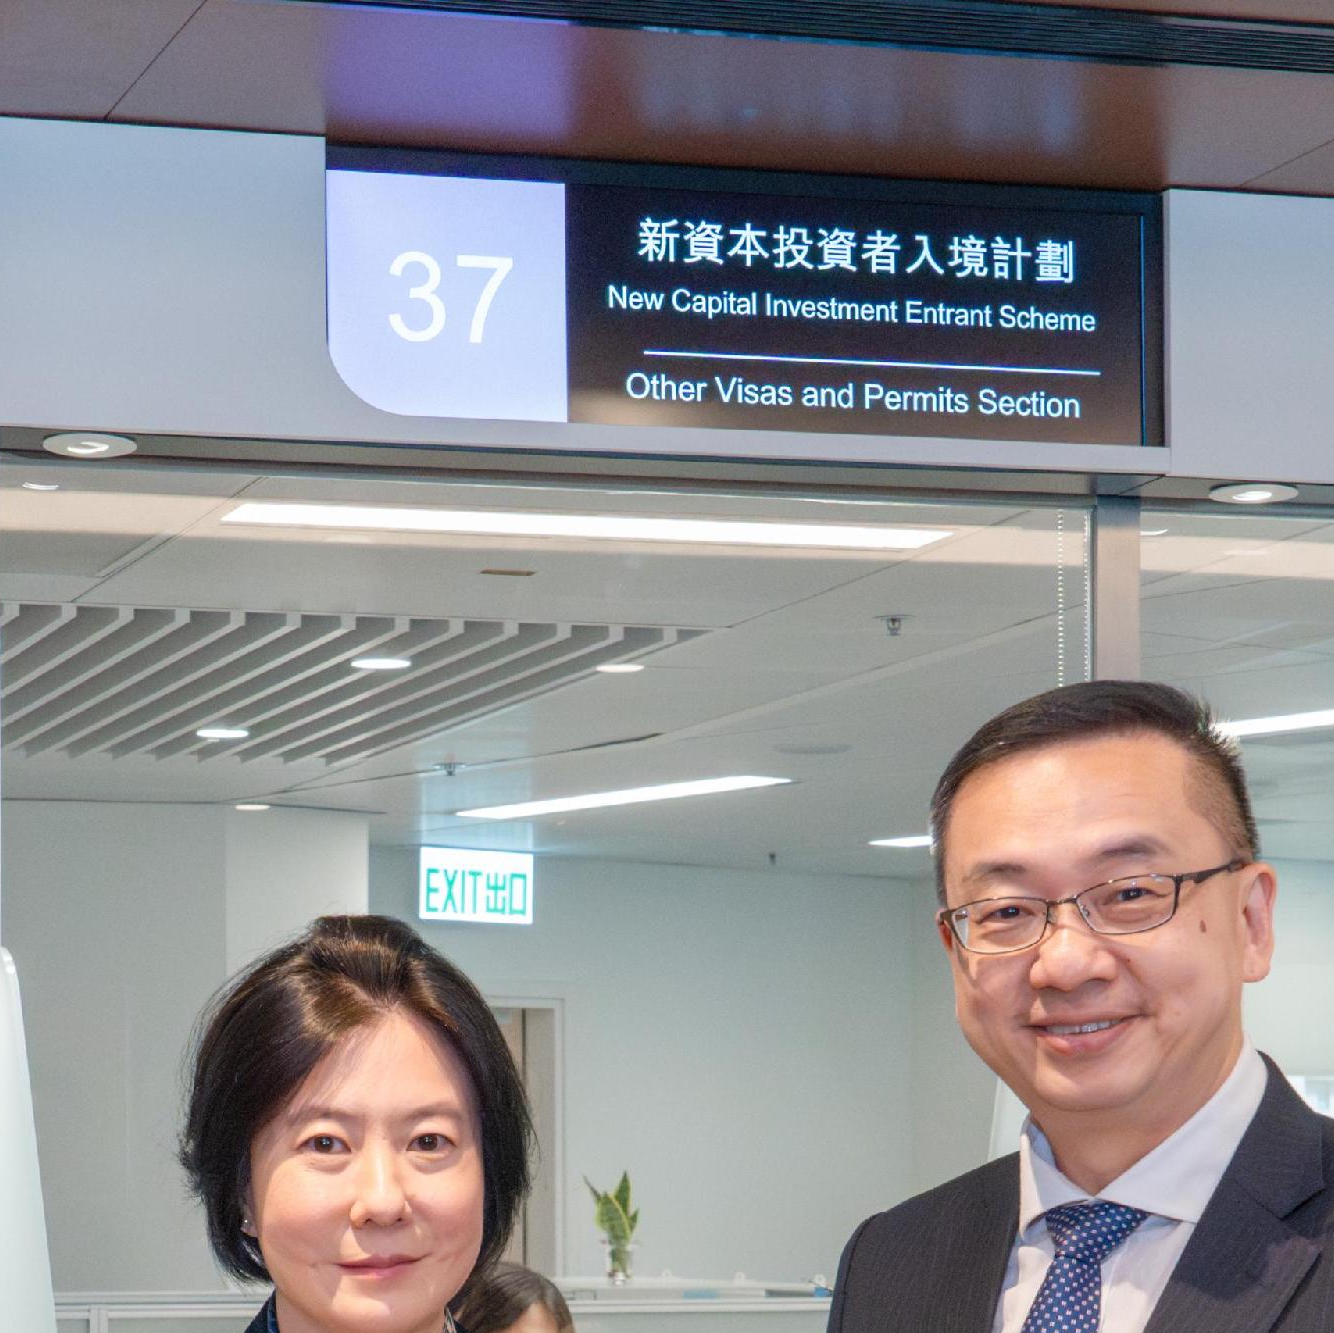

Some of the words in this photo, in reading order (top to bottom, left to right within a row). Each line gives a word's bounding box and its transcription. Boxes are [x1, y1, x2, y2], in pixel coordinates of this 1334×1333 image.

[638, 217, 1073, 283] 新資本投資者入境計劃
[389, 252, 512, 343] 37
[609, 285, 664, 310] New
[672, 289, 756, 319] Capital
[766, 293, 898, 323] Investment
[906, 301, 992, 327] Entrant
[999, 305, 1095, 331] Scheme
[626, 373, 707, 404] Other
[715, 377, 792, 405] Visas
[802, 383, 853, 408] and
[865, 384, 969, 413] Permits
[979, 389, 1080, 418] Section
[426, 868, 482, 913] EXIT
[486, 873, 527, 915] 出口
